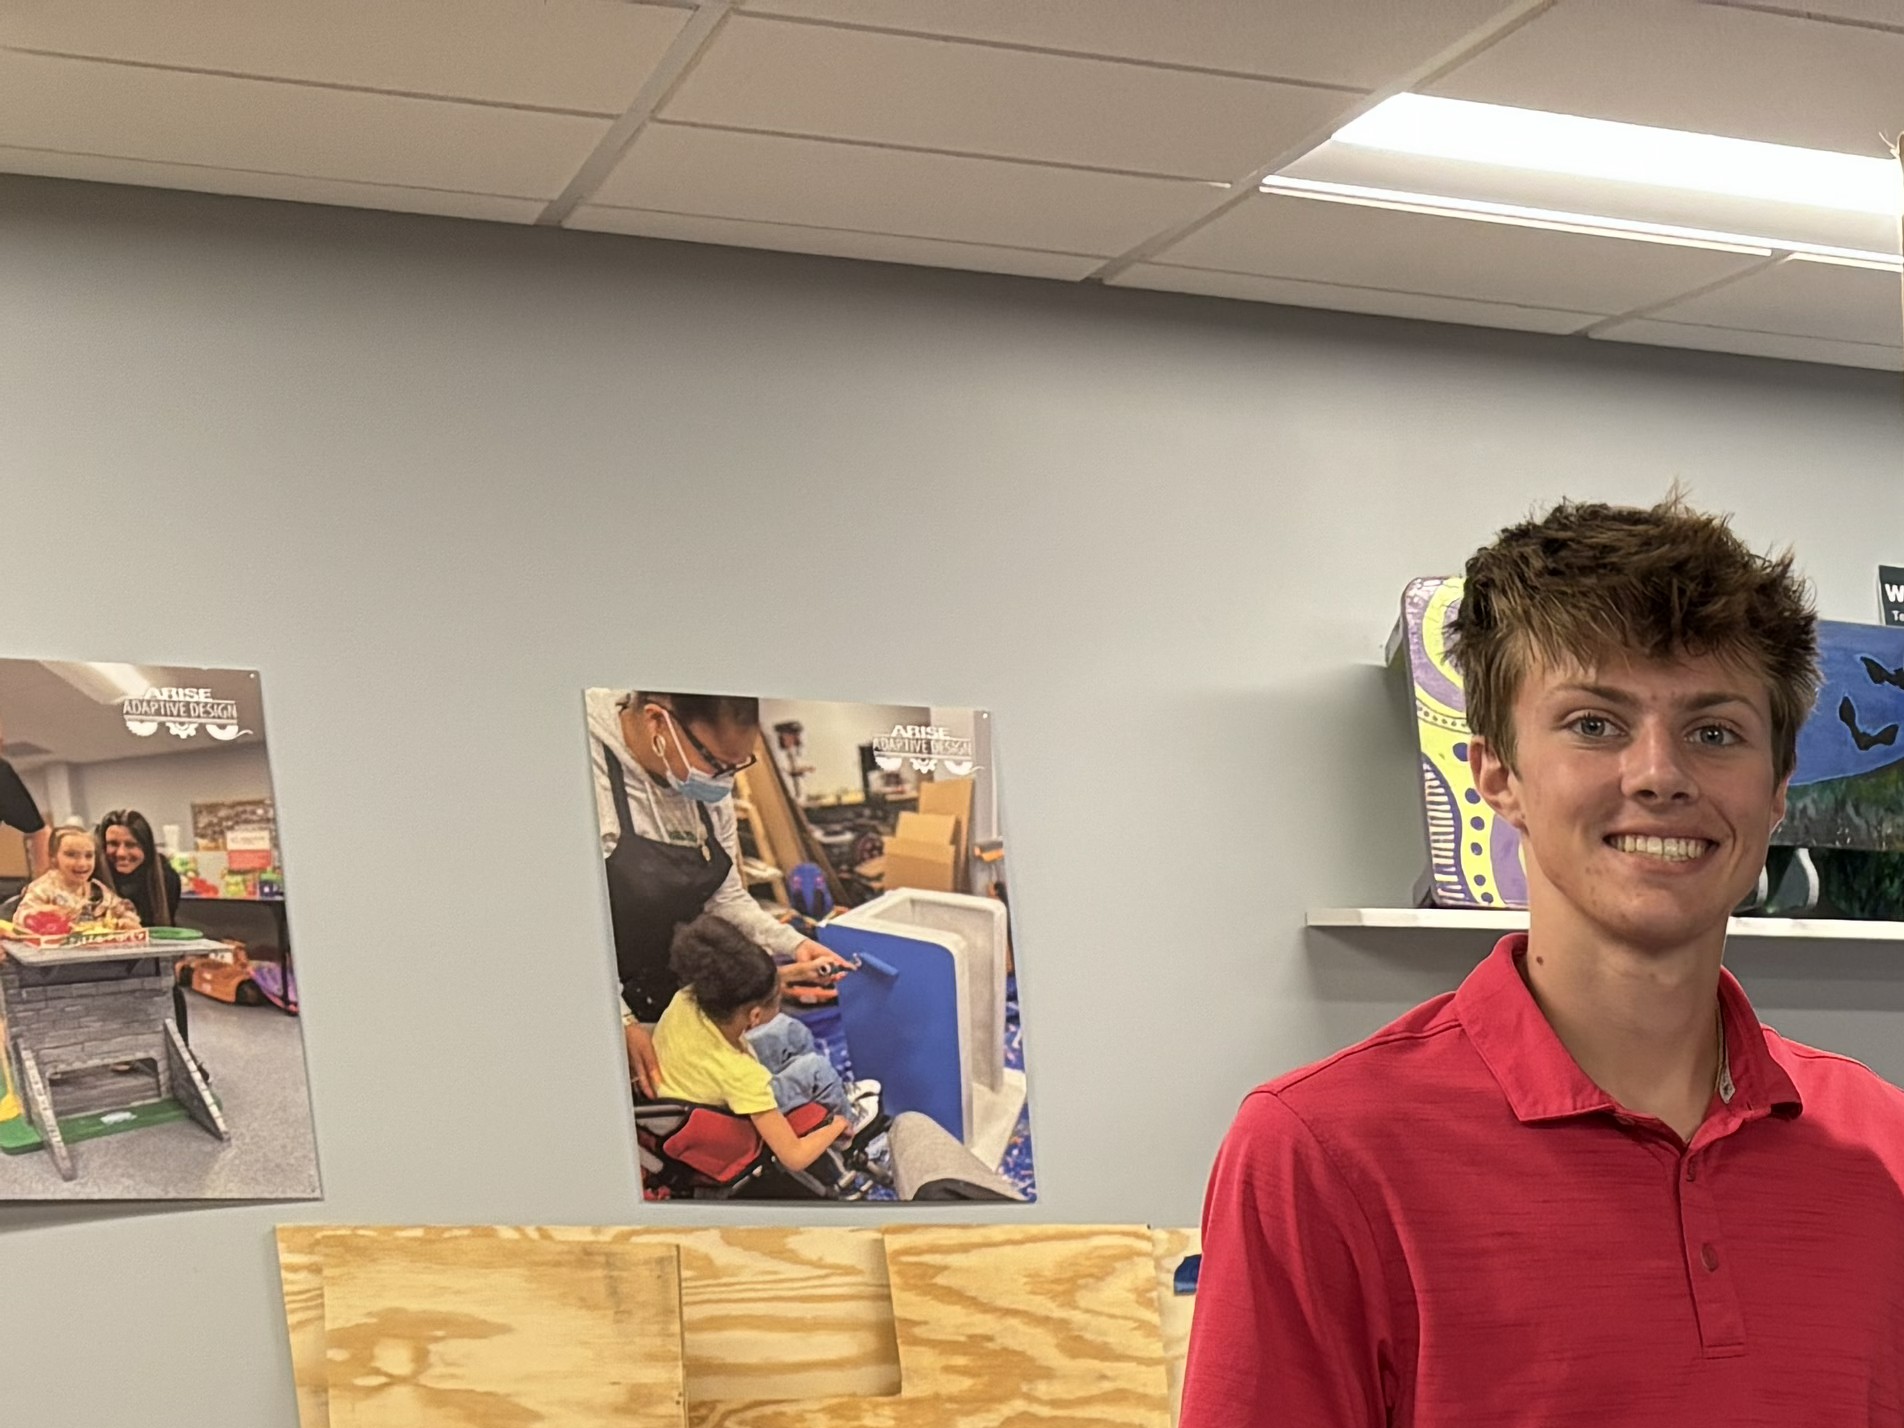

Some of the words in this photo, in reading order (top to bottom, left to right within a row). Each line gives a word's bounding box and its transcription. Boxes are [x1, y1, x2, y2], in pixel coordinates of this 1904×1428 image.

[144, 687, 213, 701] ARISE
[123, 701, 187, 716] ADAPTIVE
[190, 703, 238, 719] DESIGN
[891, 725, 951, 739] ARISE
